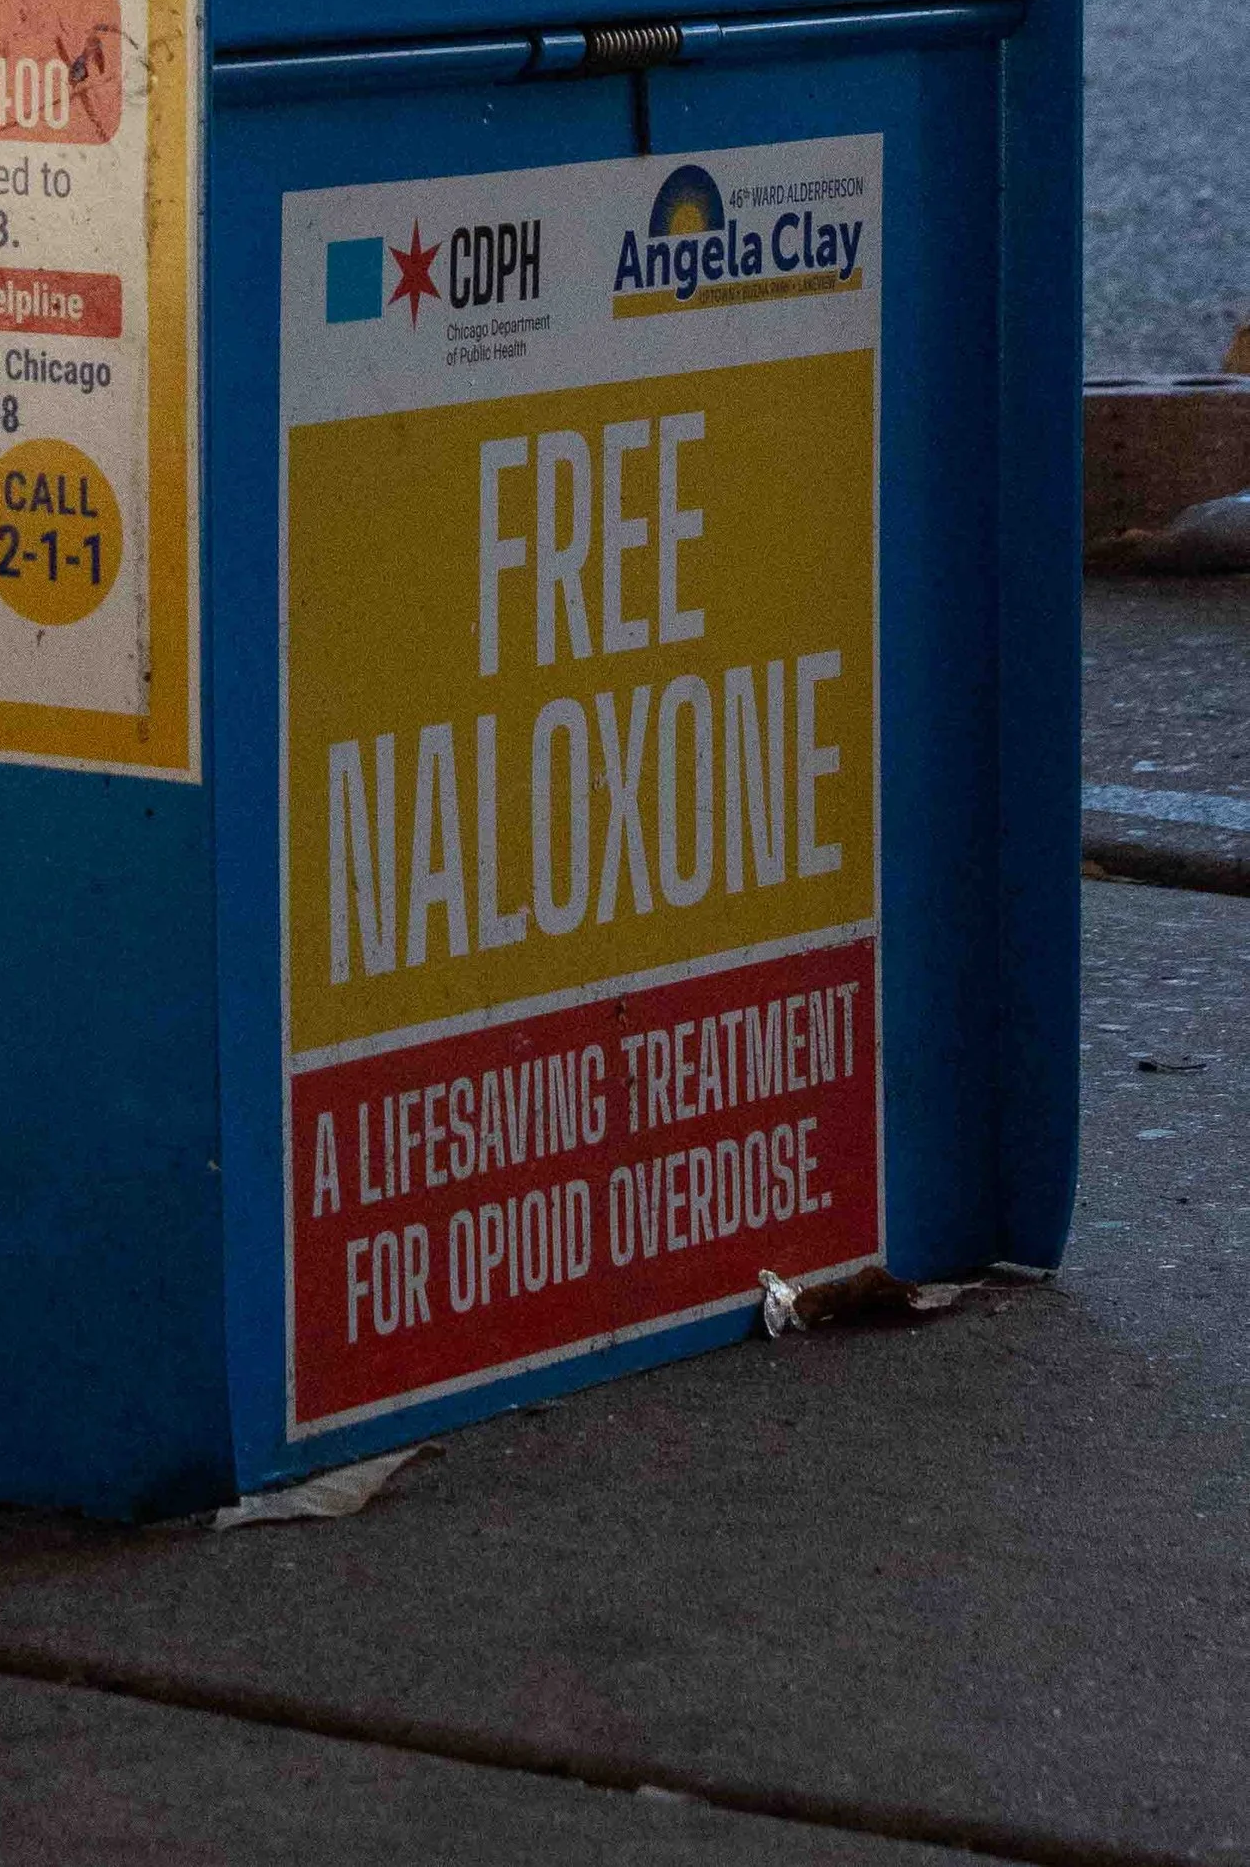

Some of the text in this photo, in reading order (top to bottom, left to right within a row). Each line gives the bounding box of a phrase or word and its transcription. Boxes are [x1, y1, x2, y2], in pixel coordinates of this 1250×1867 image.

[41, 162, 71, 198] to
[752, 184, 783, 206] WARD
[786, 177, 864, 205] ALDERPERSON
[450, 220, 541, 309] CDPH
[614, 212, 863, 300] Angela Clay
[447, 314, 550, 342] Chicago Department
[447, 340, 526, 366] of Public Health
[5, 348, 111, 393] Chicago
[4, 471, 98, 518] CALL
[478, 410, 704, 678] FREE
[329, 650, 841, 985] NALOXONE
[312, 981, 859, 1218] A LIFESAVING TREATMENT
[347, 1117, 832, 1344] FOR OPIOID OVERDOSE.
